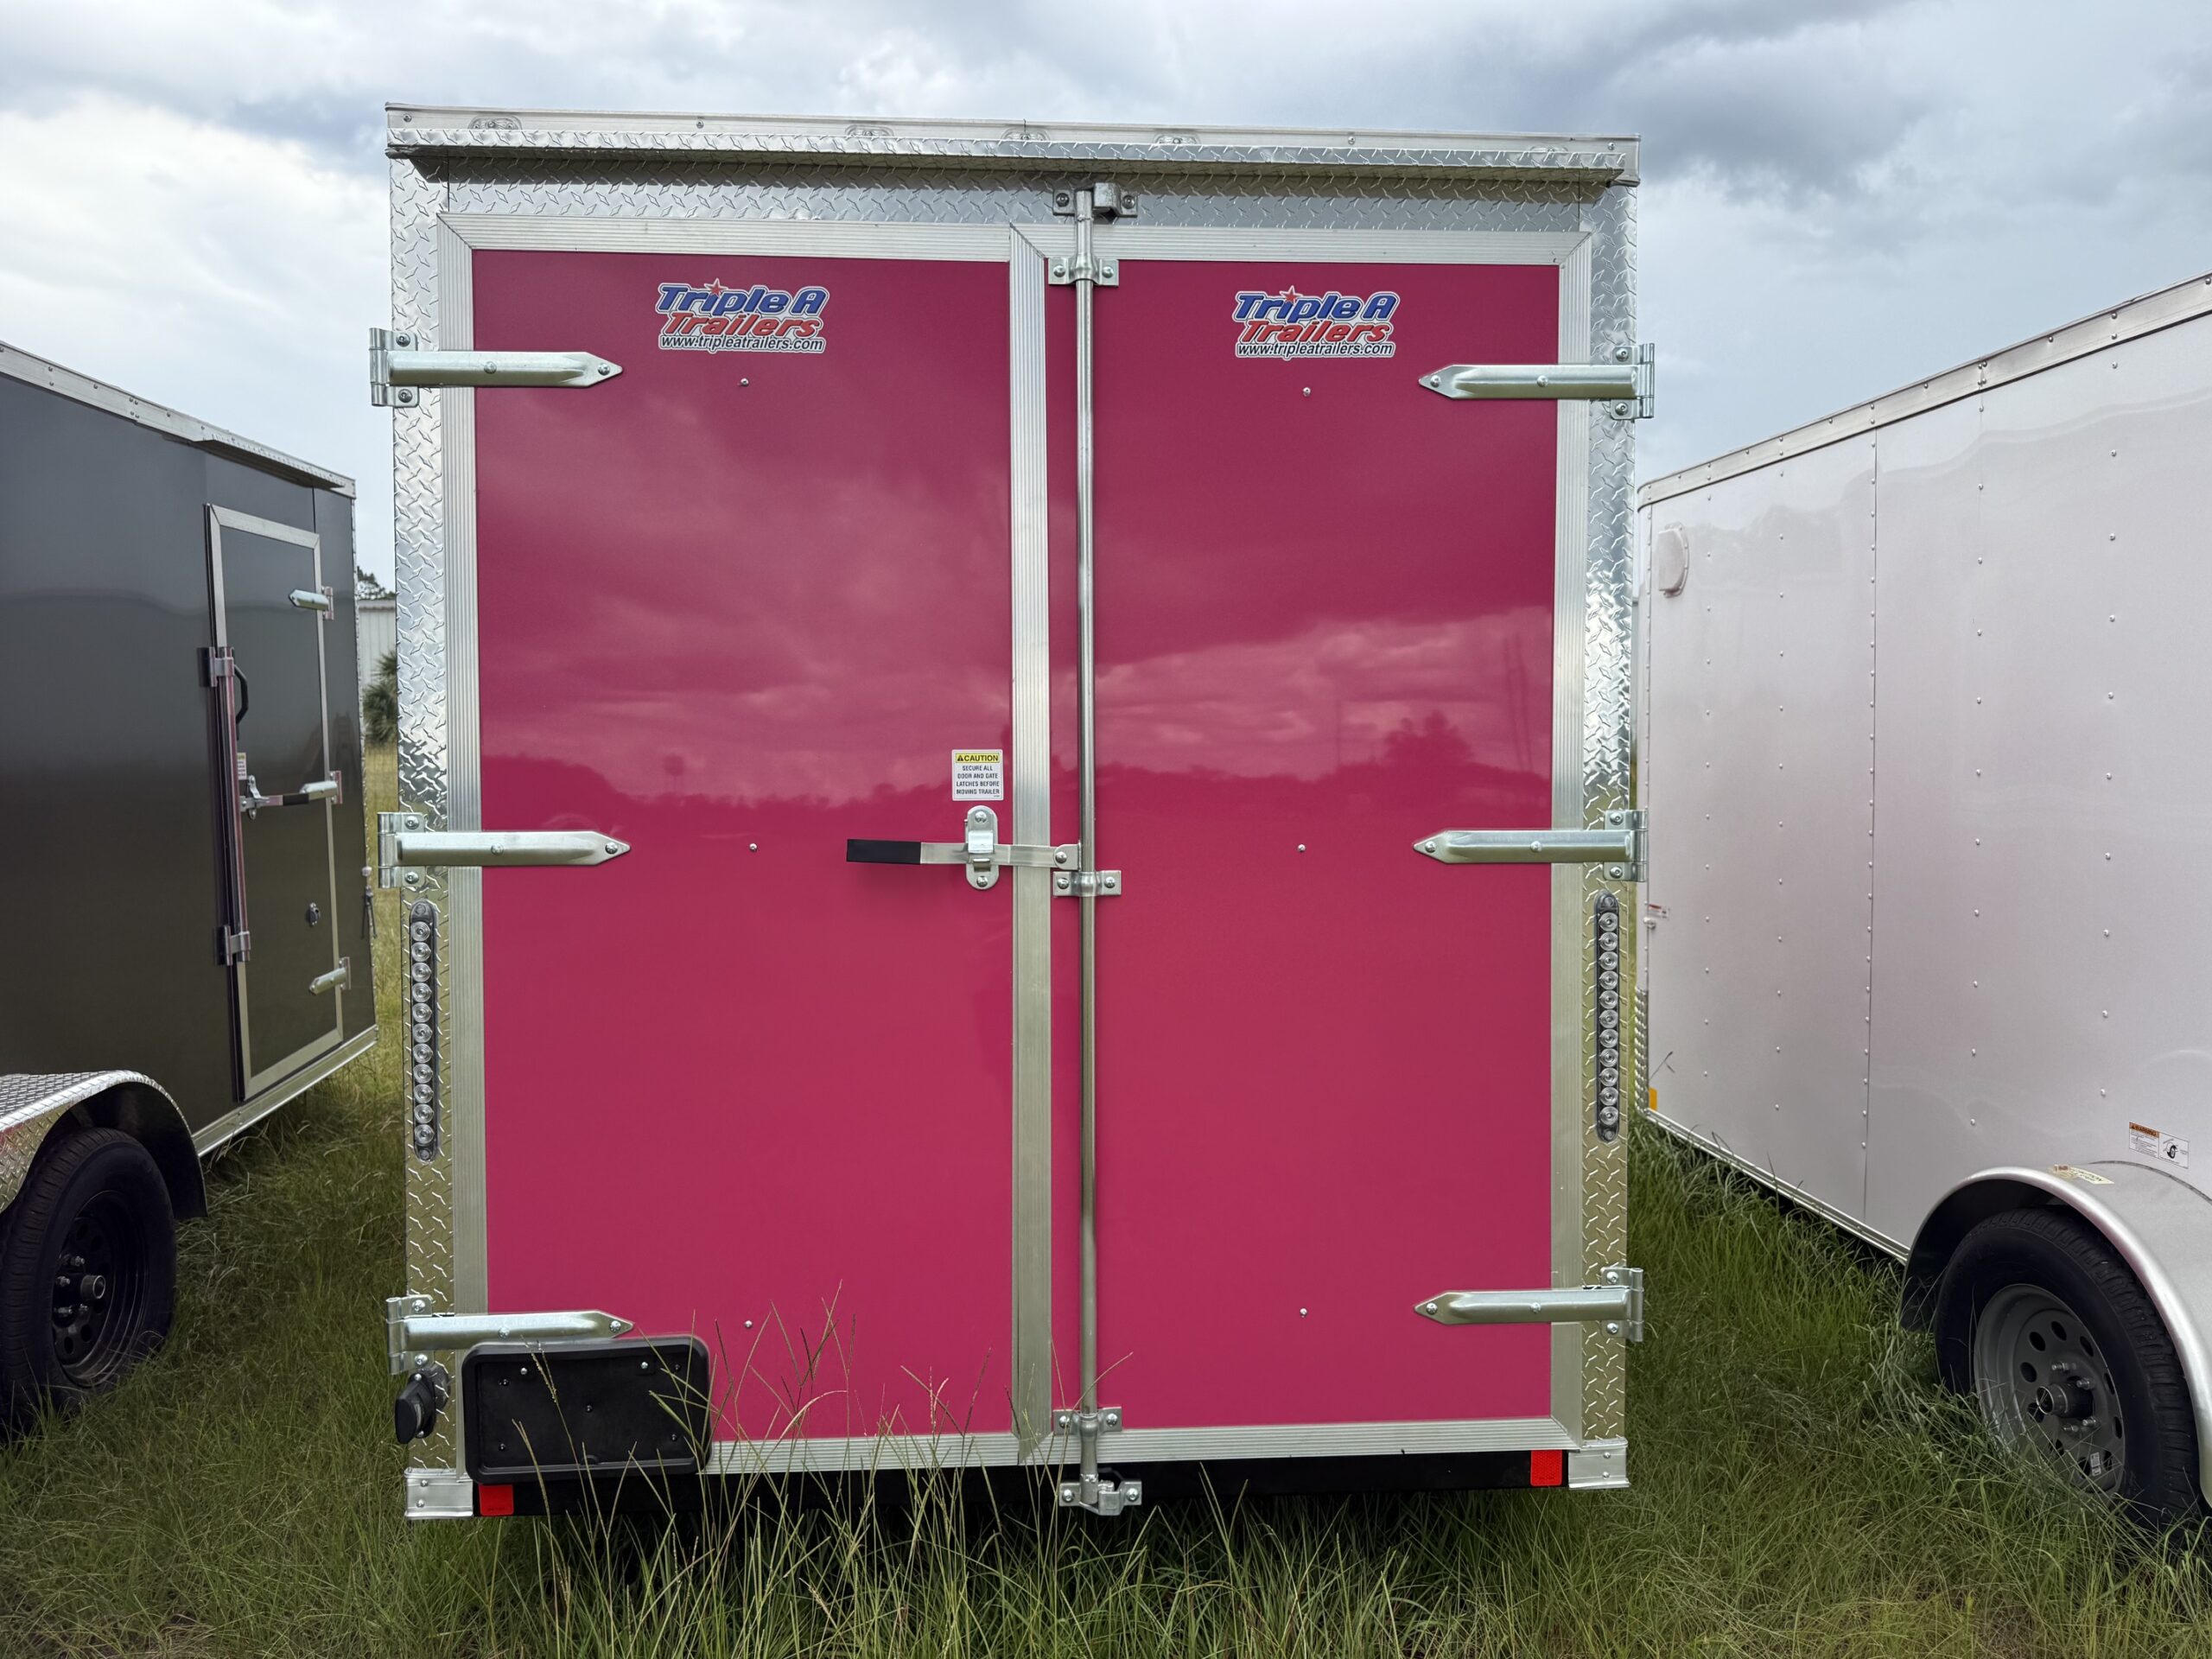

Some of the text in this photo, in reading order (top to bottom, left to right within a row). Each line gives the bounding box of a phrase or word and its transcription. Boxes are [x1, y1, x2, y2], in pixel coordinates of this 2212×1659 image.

[658, 286, 826, 316] Triple A
[1235, 295, 1397, 324] Triple A
[664, 313, 820, 337] Trailers
[1241, 321, 1390, 342] Trailers
[661, 335, 824, 351] www.tripleatrailers.com
[1238, 342, 1393, 358] www.tripleatrailers.com
[2134, 1125, 2157, 1136] WARNING
